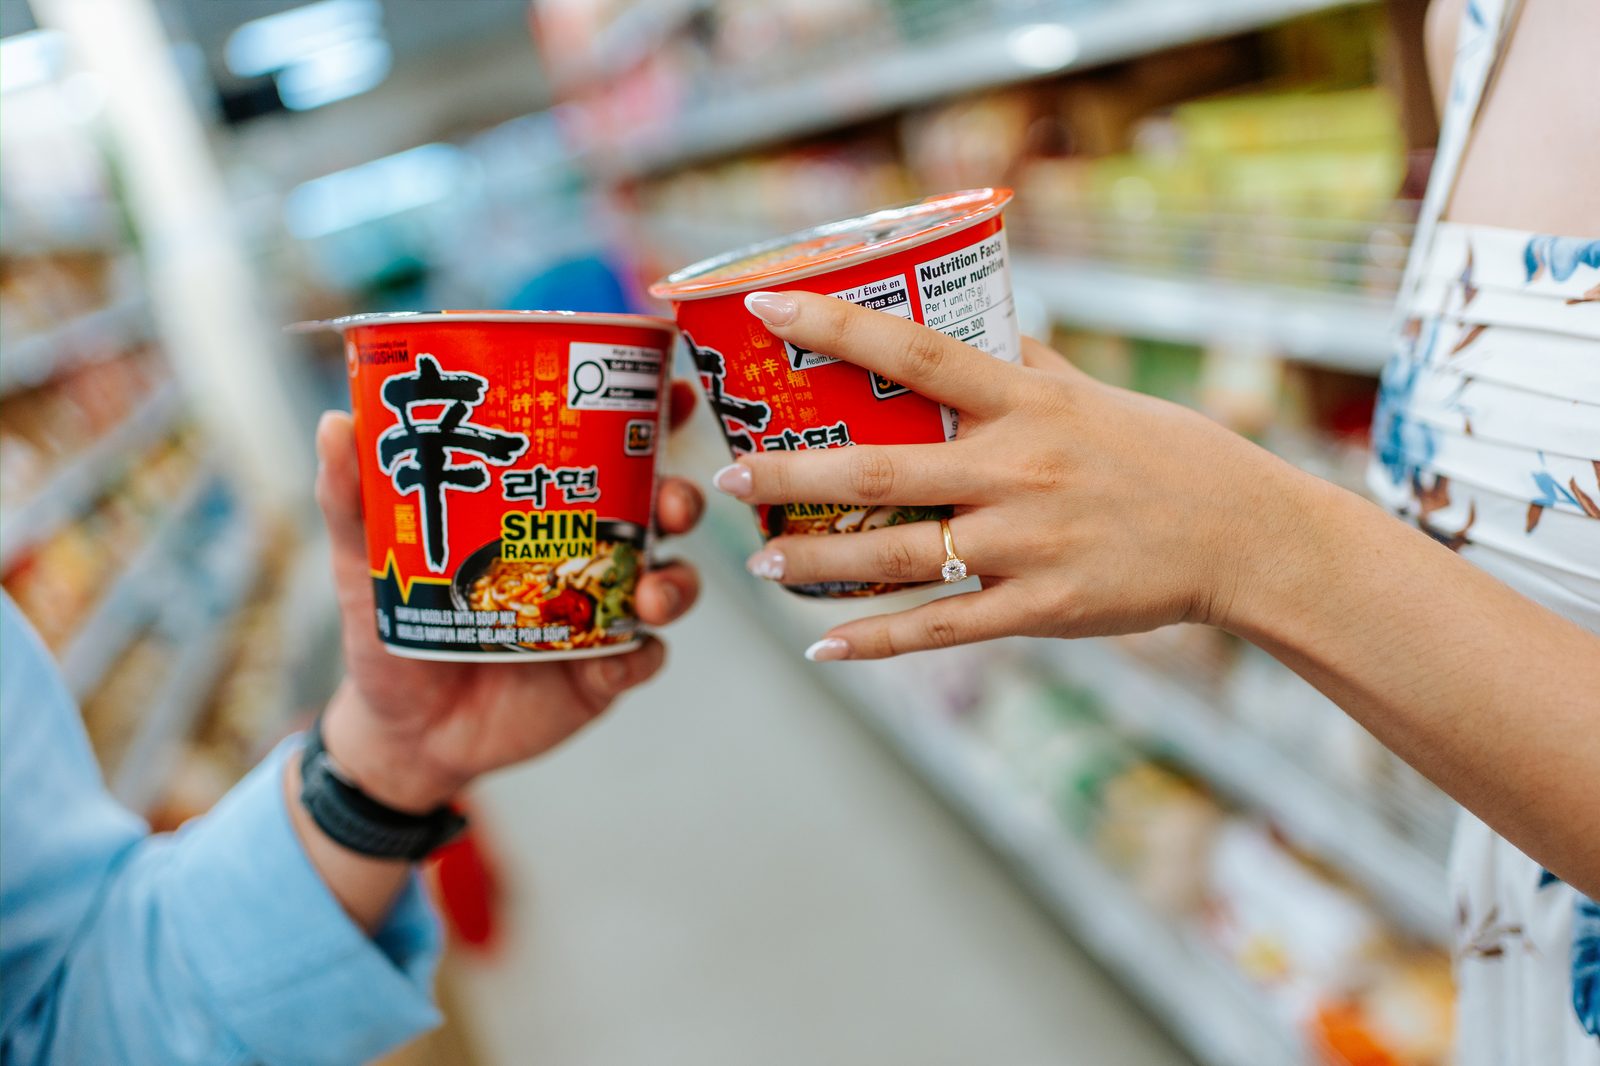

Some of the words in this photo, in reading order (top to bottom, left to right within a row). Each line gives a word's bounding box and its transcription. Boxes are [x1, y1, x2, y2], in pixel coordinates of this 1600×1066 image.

[920, 252, 978, 282] Nutrition
[980, 240, 1001, 260] Facts
[863, 282, 888, 296] Élevé
[889, 279, 901, 289] en
[923, 275, 967, 300] Valeur
[864, 298, 886, 309] Gras
[887, 292, 904, 304] sat.
[925, 302, 940, 314] Per
[942, 298, 947, 308] 1
[949, 292, 964, 305] unit
[927, 314, 946, 328] pour
[948, 310, 953, 320] 1
[970, 317, 985, 331] 300
[805, 356, 828, 366] Health
[378, 355, 527, 571] 辛
[503, 466, 599, 507] 라면
[503, 512, 594, 541] SHIN
[503, 542, 594, 560] RAMYUN
[454, 610, 475, 625] WITH
[476, 611, 498, 626] SOUP
[499, 611, 517, 625] MIX
[518, 627, 542, 643] POUR
[543, 626, 571, 642] SOUPE
